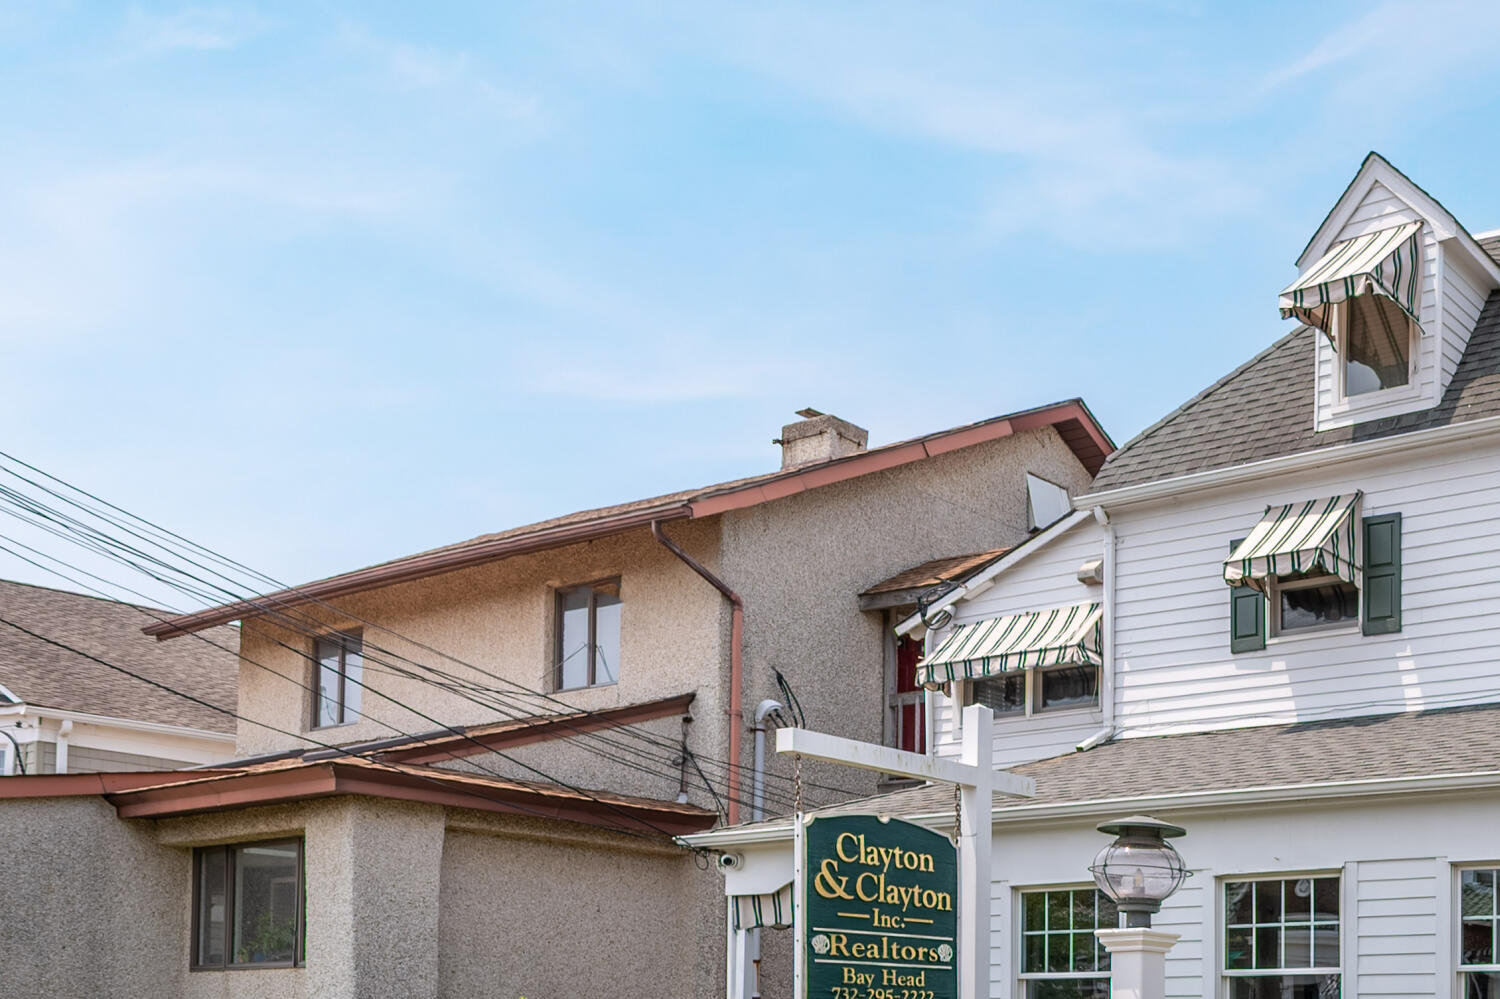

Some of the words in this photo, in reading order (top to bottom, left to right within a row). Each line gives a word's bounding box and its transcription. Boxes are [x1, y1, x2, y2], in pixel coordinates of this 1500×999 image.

[836, 832, 934, 873] Clayton
[814, 858, 854, 900] &
[855, 872, 952, 912] Clayton
[872, 908, 906, 929] Inc.
[829, 934, 938, 962] Realtors
[843, 967, 875, 989] Bay
[882, 969, 926, 988] Head
